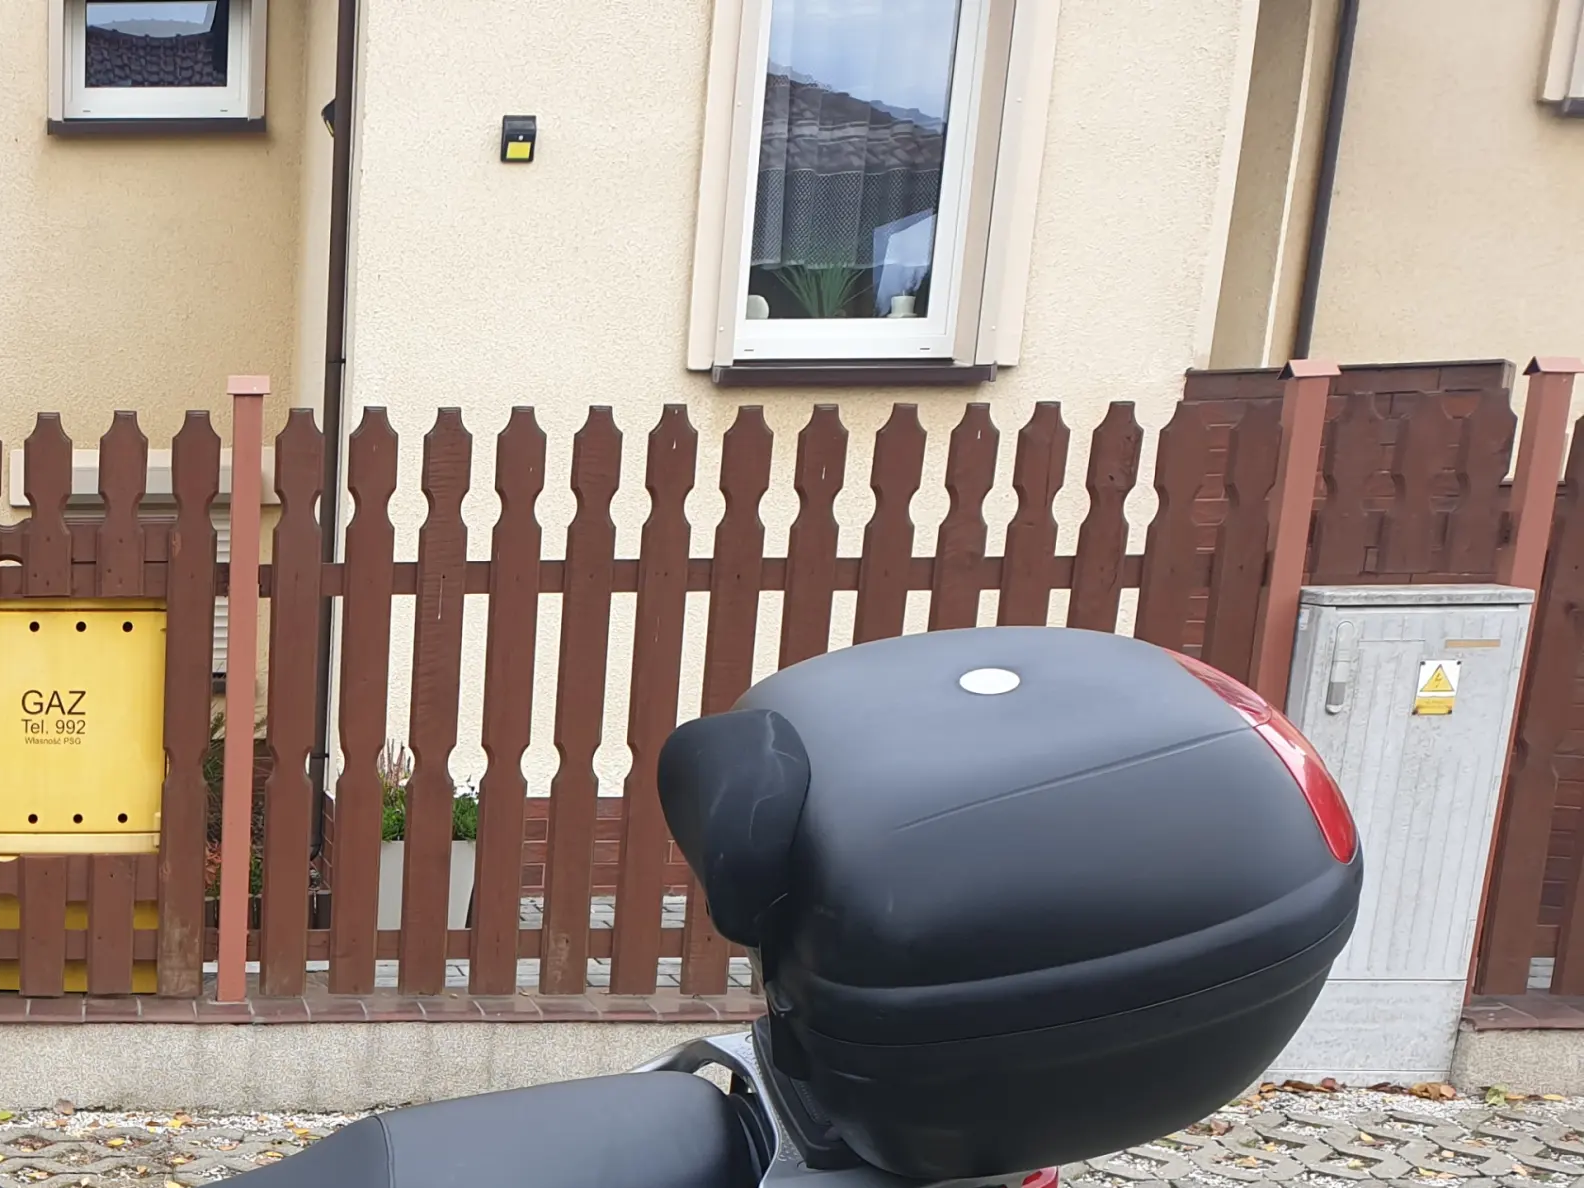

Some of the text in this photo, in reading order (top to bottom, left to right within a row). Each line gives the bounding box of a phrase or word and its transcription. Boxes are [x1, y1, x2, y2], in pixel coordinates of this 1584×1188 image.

[21, 689, 87, 716] GAZ
[20, 718, 86, 735] Tel. 992
[63, 736, 82, 745] PSG
